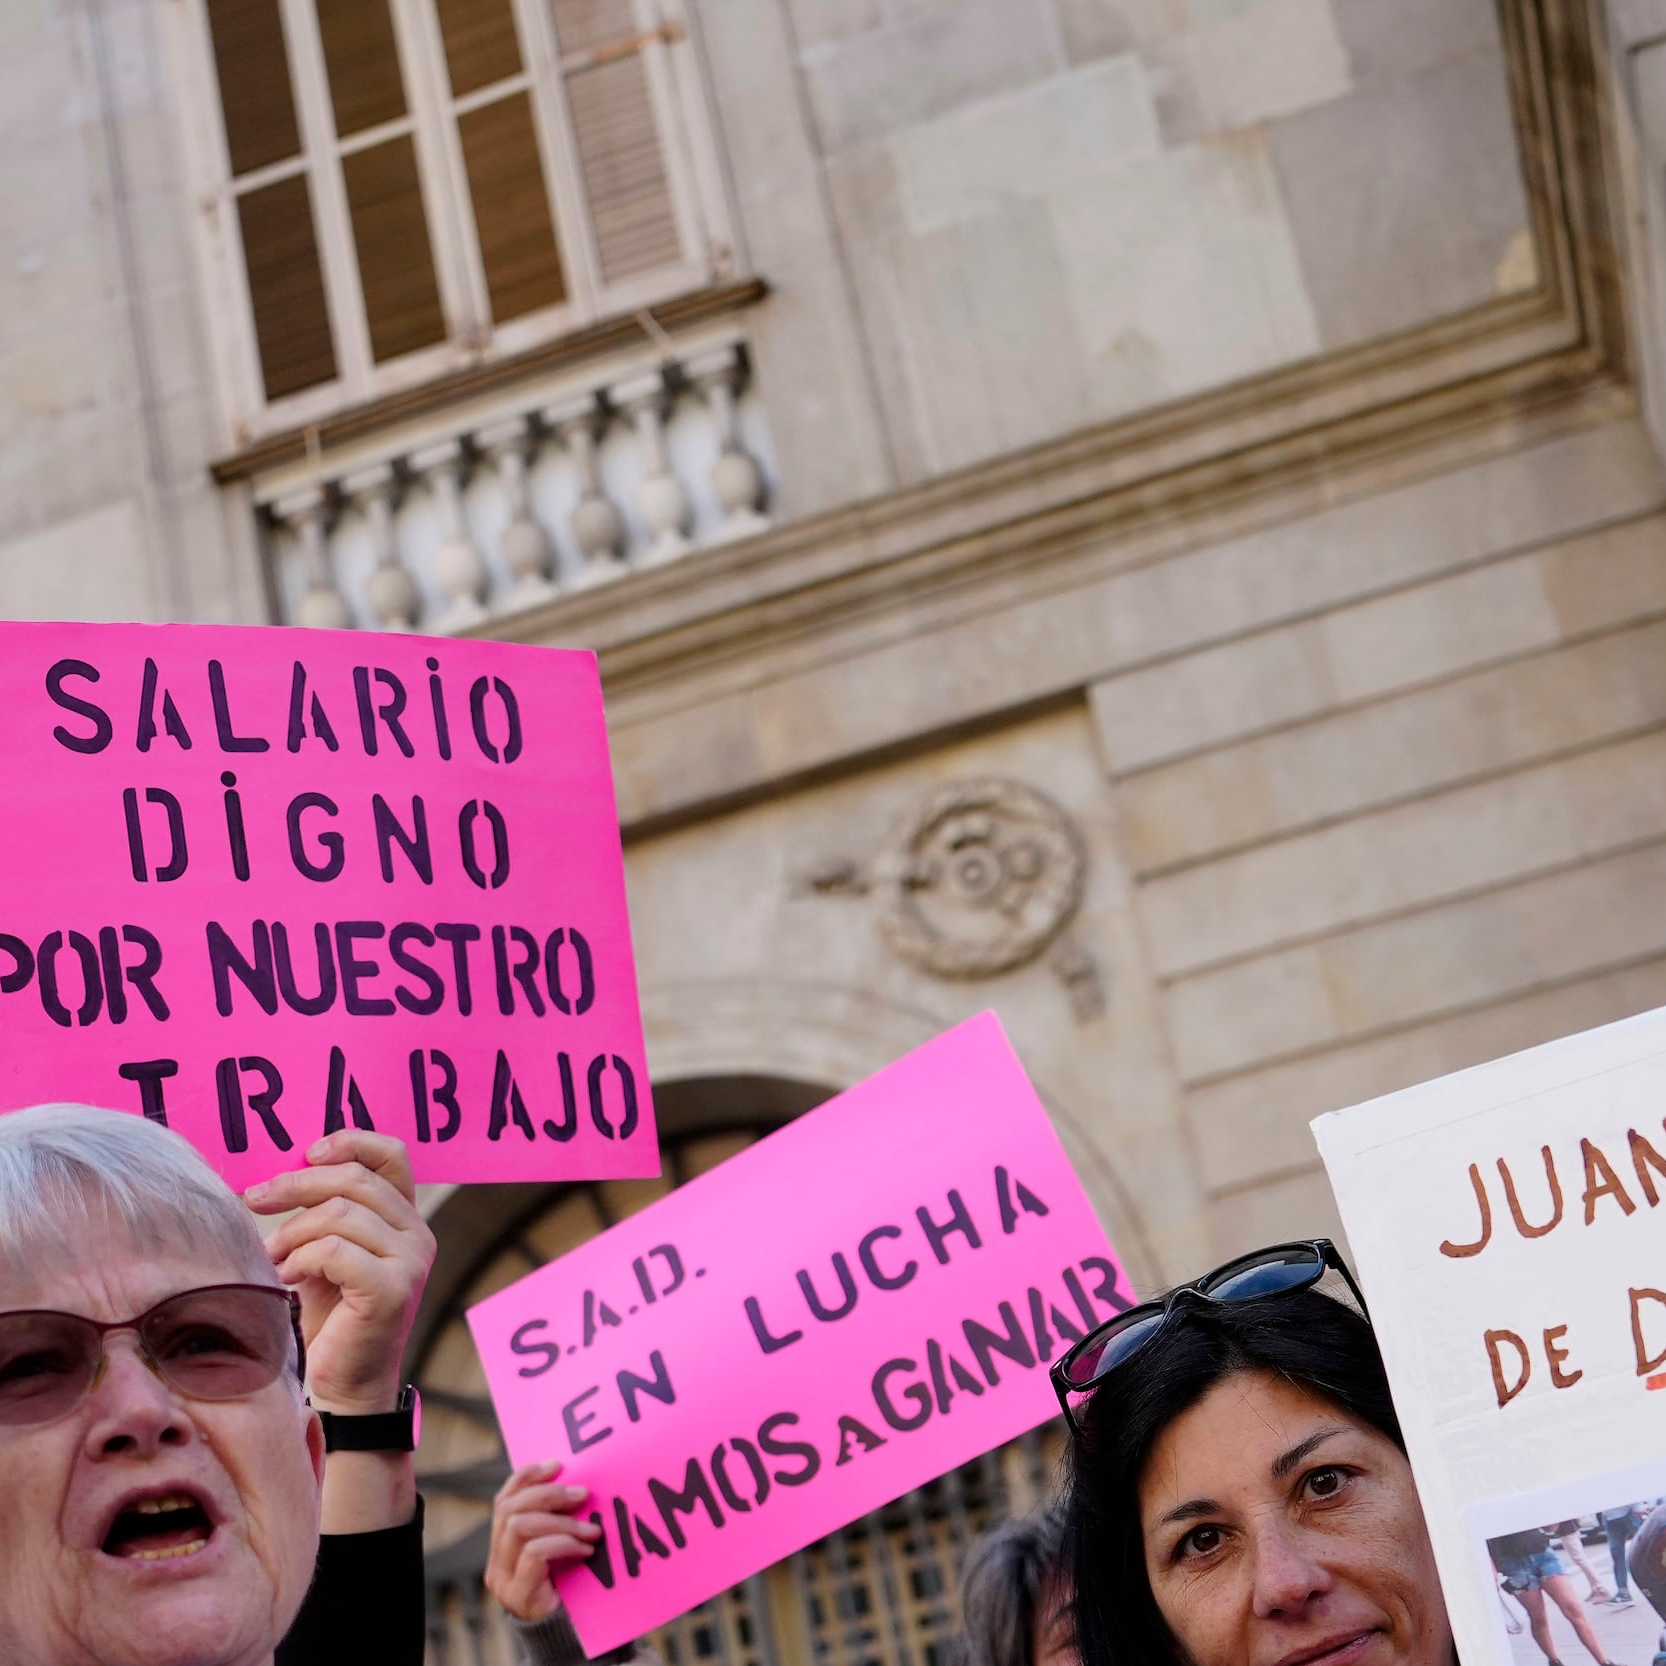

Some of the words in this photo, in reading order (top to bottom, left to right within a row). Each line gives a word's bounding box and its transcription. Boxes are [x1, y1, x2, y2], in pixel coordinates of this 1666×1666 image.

[205, 918, 597, 1019] NUESTRO
[117, 1045, 641, 1156] TRABAJO
[509, 1242, 707, 1381] S.A.D.
[558, 1349, 677, 1456] EN
[743, 1164, 1050, 1355] LUCHA
[1484, 1324, 1584, 1410] DE
[585, 1409, 821, 1591] VAMOS
[871, 1254, 1136, 1430] GANAR
